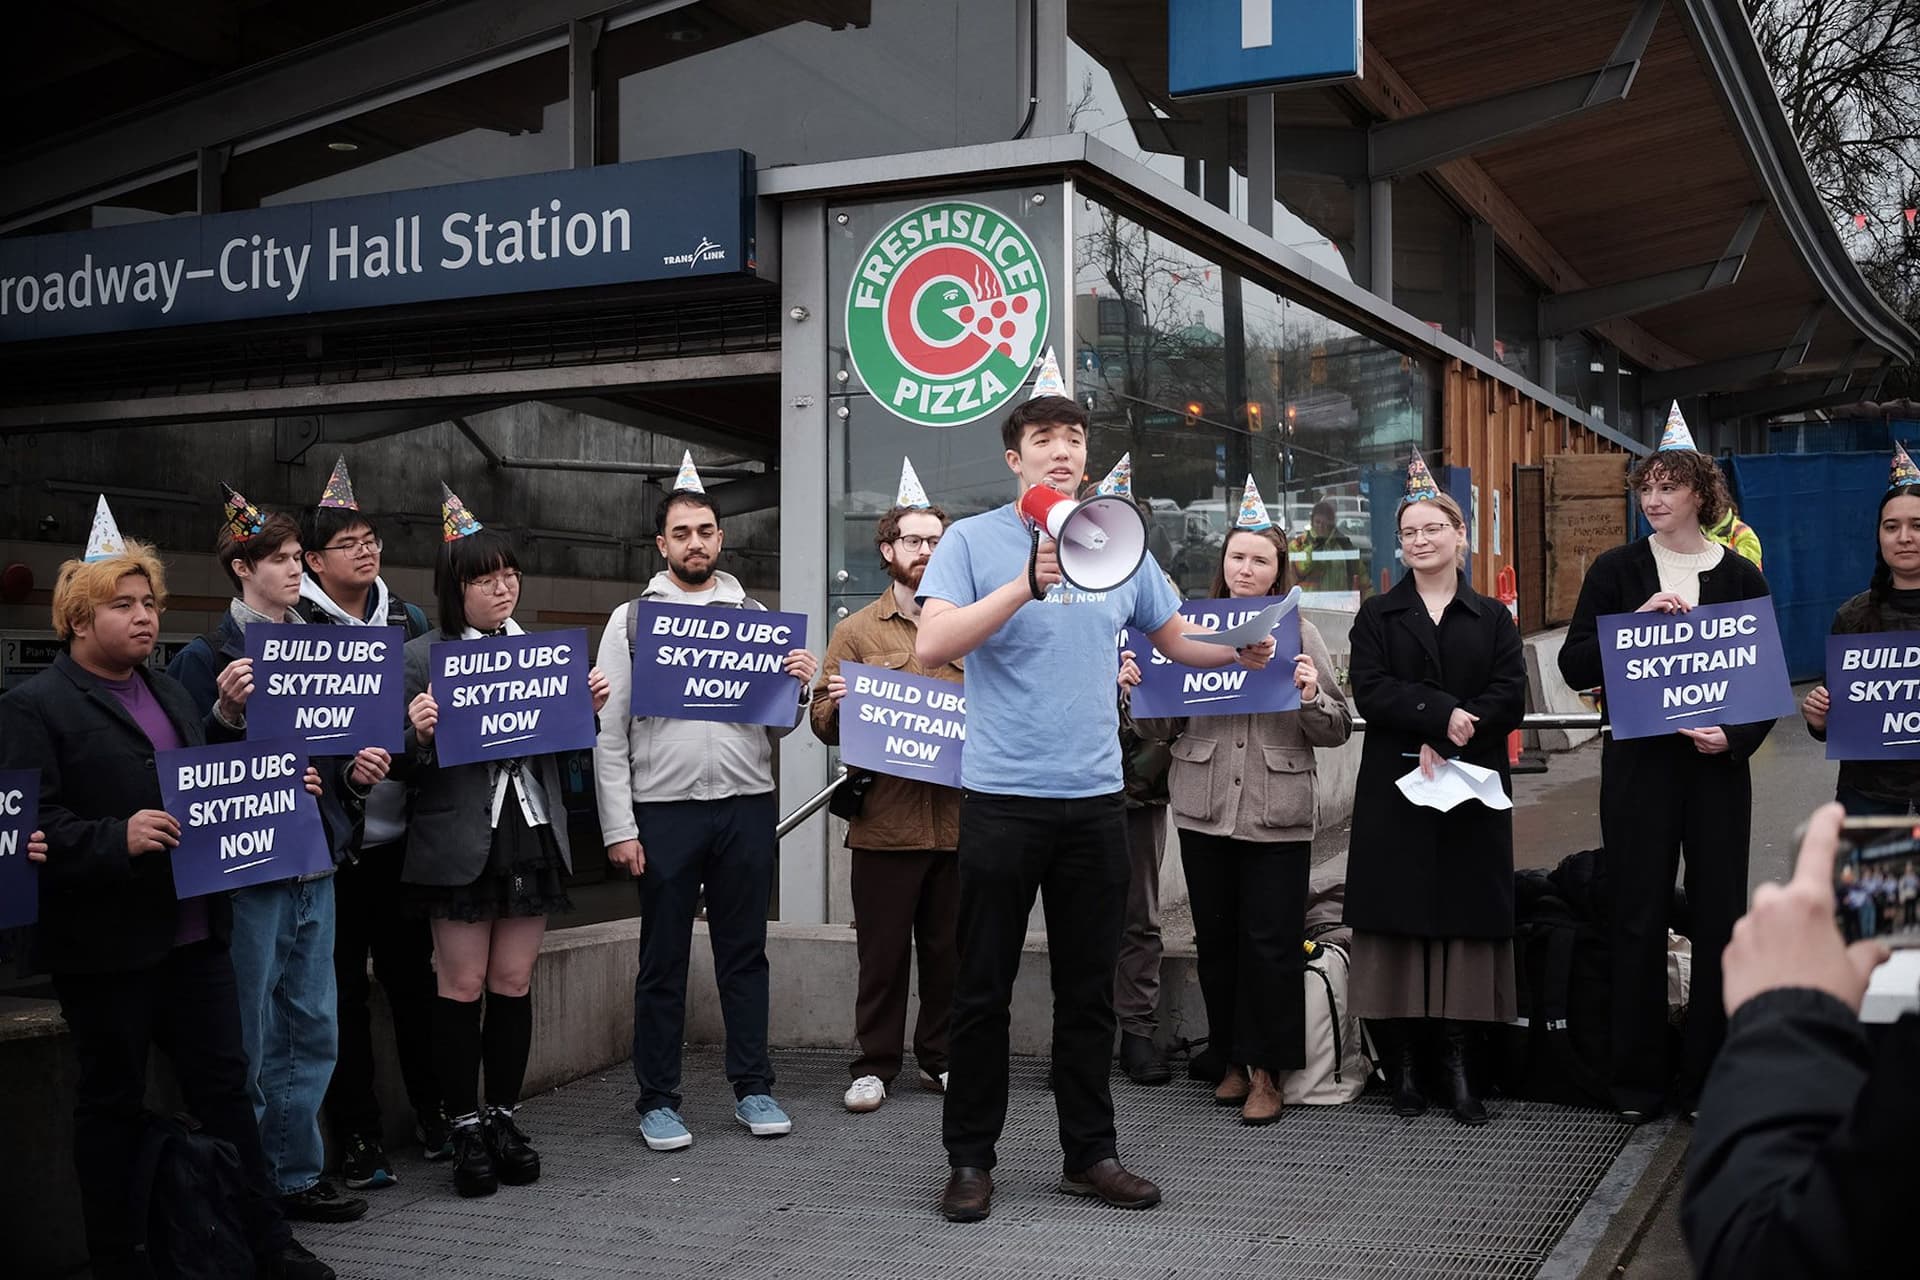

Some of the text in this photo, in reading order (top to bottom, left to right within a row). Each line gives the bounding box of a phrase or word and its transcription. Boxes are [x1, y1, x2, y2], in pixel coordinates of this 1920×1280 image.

[2, 200, 630, 314] roadway–City Hall Station
[855, 210, 1037, 308] FRESHSLICE
[893, 370, 1007, 414] PIZZA
[1076, 591, 1108, 604] NOW
[653, 616, 791, 644] BUILD UBC
[1617, 615, 1756, 649] BUILD UBC
[263, 640, 386, 662] BUILD UBC
[445, 645, 571, 676] BUILD UBC
[656, 646, 786, 673] SKYTRAIN
[1626, 645, 1756, 679] SKYTRAIN
[1843, 647, 1920, 670] BUILD
[267, 674, 381, 695] SKYTRAIN
[453, 676, 568, 707] SKYTRAIN
[684, 678, 749, 699] NOW
[855, 676, 921, 703] BUILD
[1183, 671, 1247, 692] NOW
[1664, 681, 1728, 707] NOW
[1849, 680, 1920, 701] SKYT
[296, 707, 354, 728] NOW
[481, 710, 540, 735] NOW
[859, 704, 966, 740] SKYTRAIN
[1883, 712, 1920, 733] NO
[886, 736, 940, 761] NOW
[179, 753, 296, 790] BUILD UBC
[189, 789, 295, 826] SKYTRAIN
[221, 828, 274, 859] NOW
